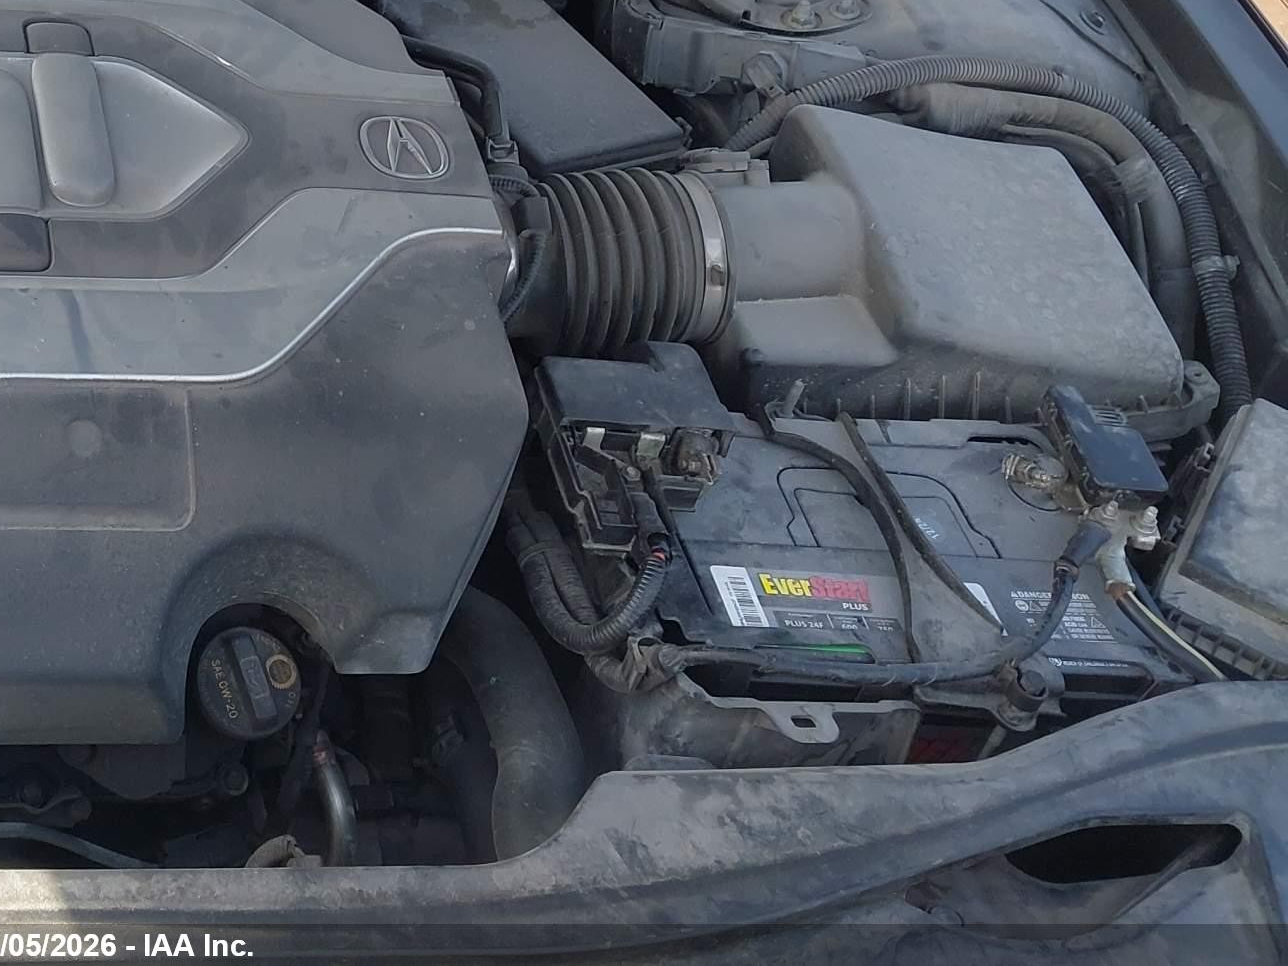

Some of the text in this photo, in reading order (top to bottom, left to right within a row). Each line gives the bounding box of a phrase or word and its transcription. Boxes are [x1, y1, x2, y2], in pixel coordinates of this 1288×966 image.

[759, 573, 871, 603] EverStart
[842, 602, 869, 612] PLUS
[784, 618, 808, 629] PLUS
[212, 659, 226, 680] SAE
